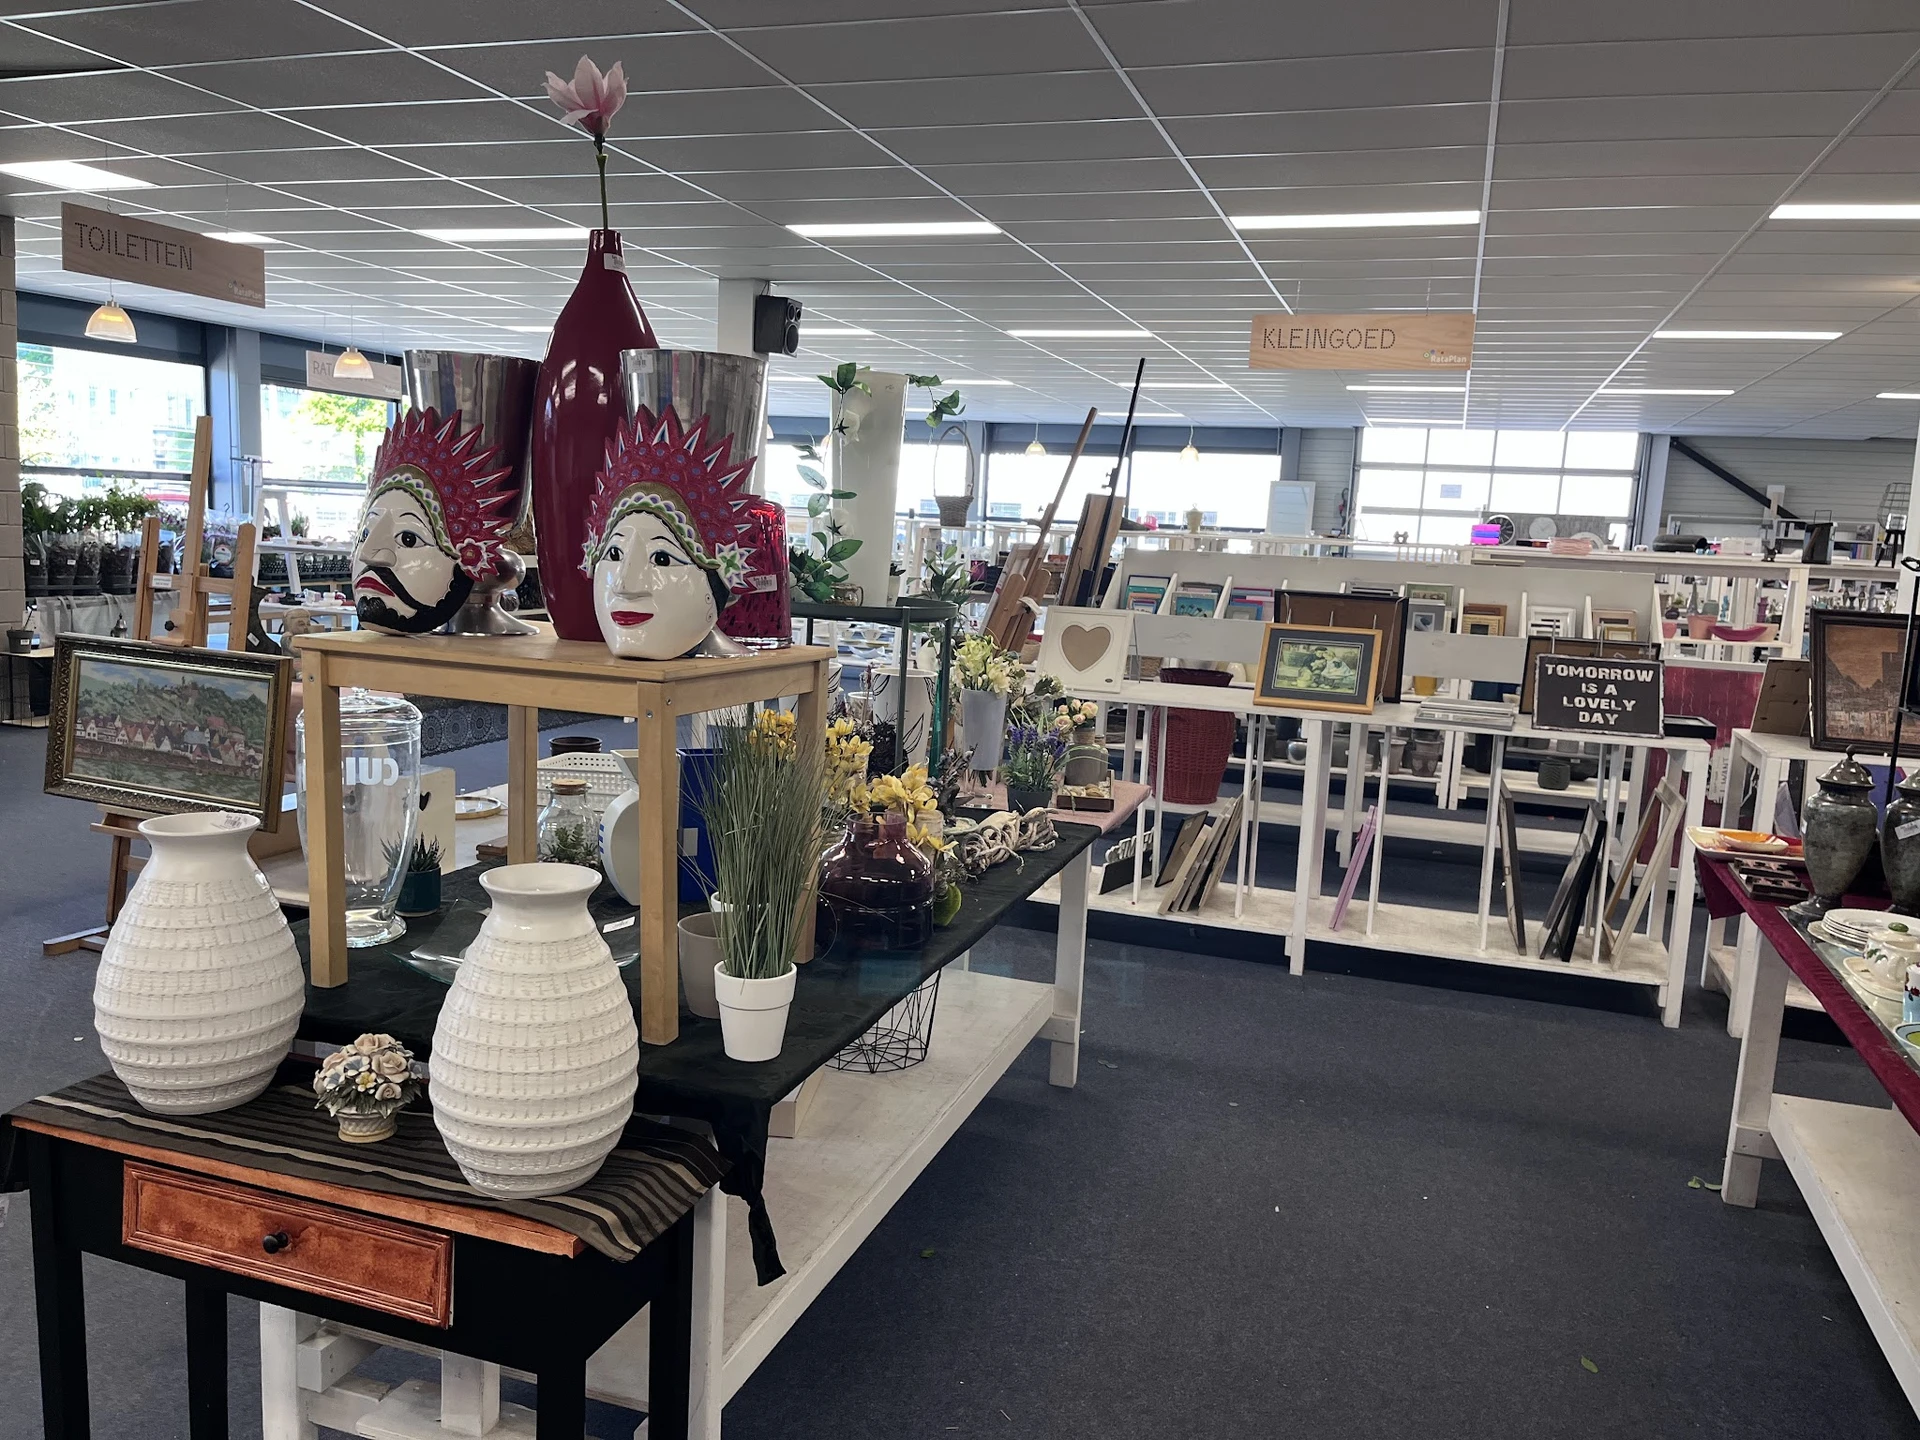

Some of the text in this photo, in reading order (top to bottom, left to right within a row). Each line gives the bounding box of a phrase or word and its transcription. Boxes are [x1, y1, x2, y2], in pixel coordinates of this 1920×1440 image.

[74, 221, 193, 271] TOILETTEN
[1263, 328, 1396, 349] KLEINGOED
[1430, 355, 1467, 363] RataPlan
[1545, 663, 1654, 682] TOMORROW
[1581, 682, 1618, 695] IS A
[1562, 695, 1636, 711] LOVELY
[1578, 711, 1619, 725] DAY
